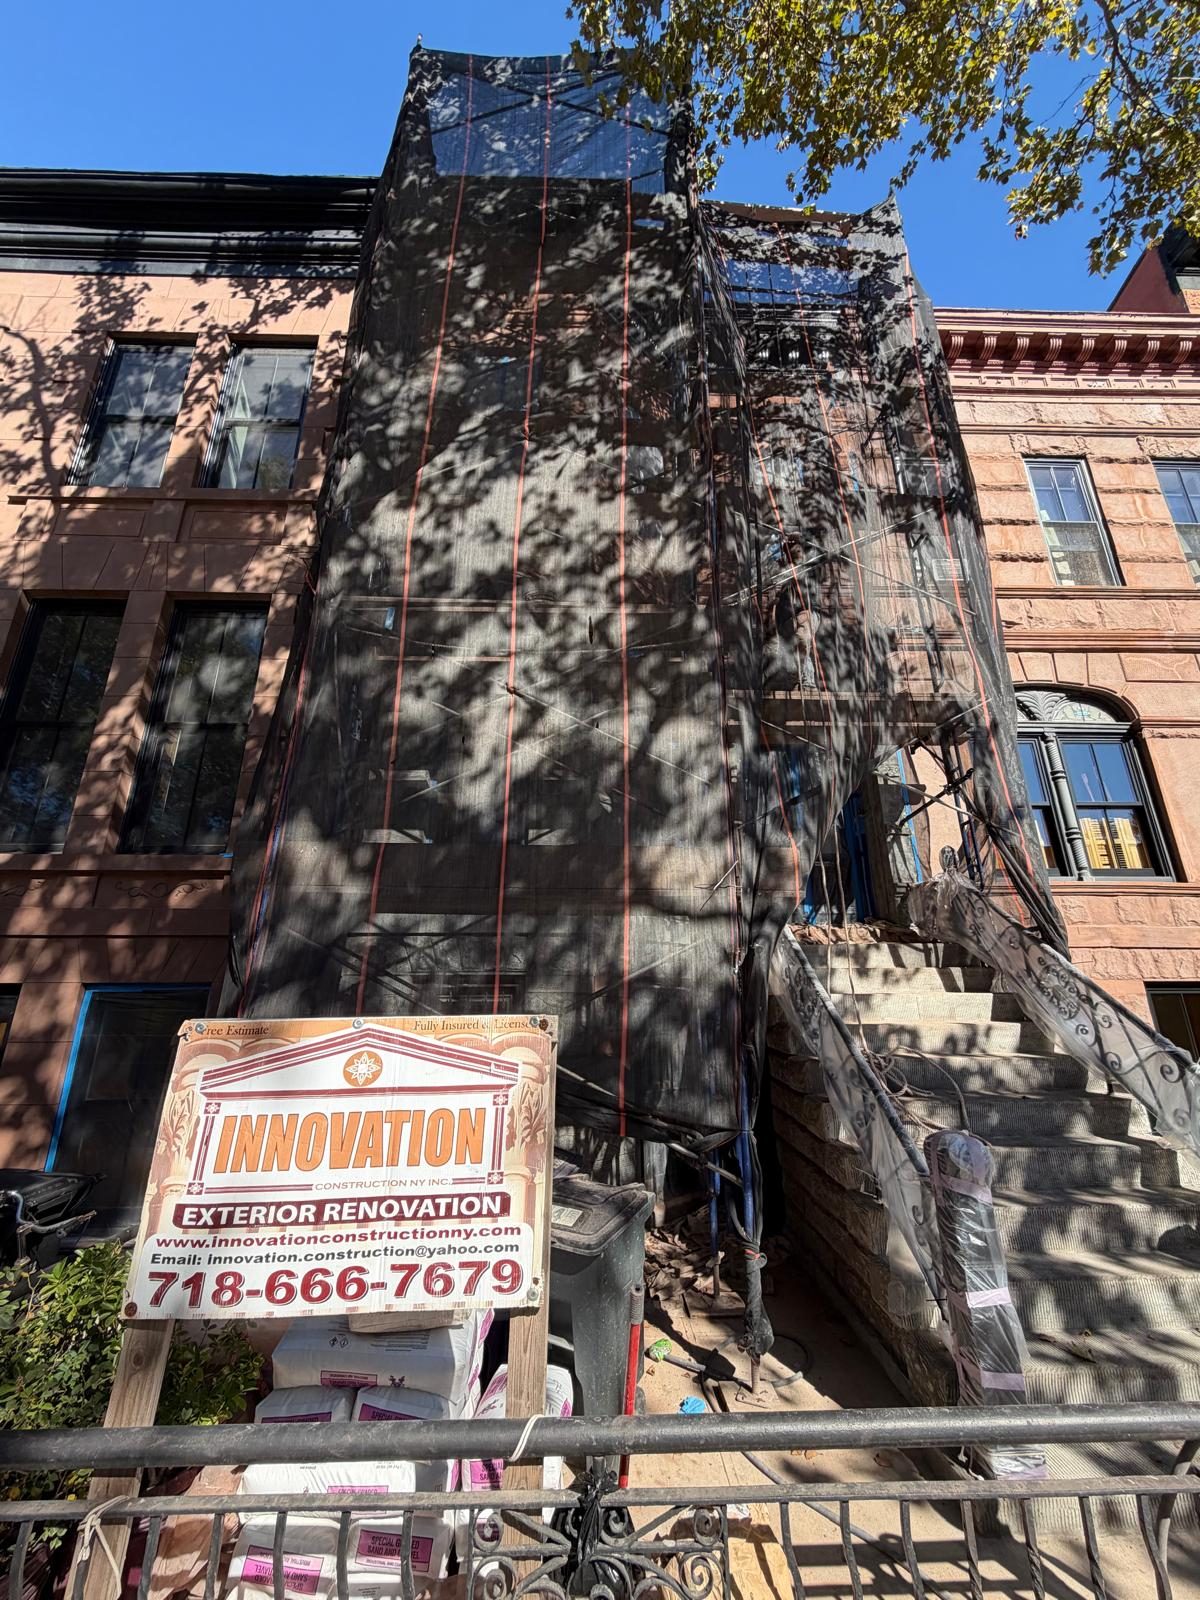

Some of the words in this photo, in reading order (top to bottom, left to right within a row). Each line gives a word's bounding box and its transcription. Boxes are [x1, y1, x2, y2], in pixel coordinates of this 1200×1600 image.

[199, 1025, 223, 1036] ree
[226, 1024, 270, 1036] Estimate
[414, 1020, 439, 1032] Fully
[441, 1019, 480, 1031] Insured
[213, 1108, 486, 1174] INNOVATION
[315, 1179, 407, 1191] CONSTRUCTION
[409, 1179, 427, 1187] NY
[182, 1203, 317, 1226] EXTERIOR
[323, 1195, 501, 1222] RENOVATION
[156, 1225, 521, 1249] www.innovationconstructionny.com
[150, 1253, 202, 1266] Email:
[207, 1243, 520, 1266] innovation.construction@yahoo.com
[148, 1258, 524, 1309] 718-666-7679
[370, 1535, 395, 1547] SPECIAL
[367, 1545, 384, 1556] SAND
[255, 1564, 273, 1575] RAVEL
[291, 1572, 309, 1582] SAND
